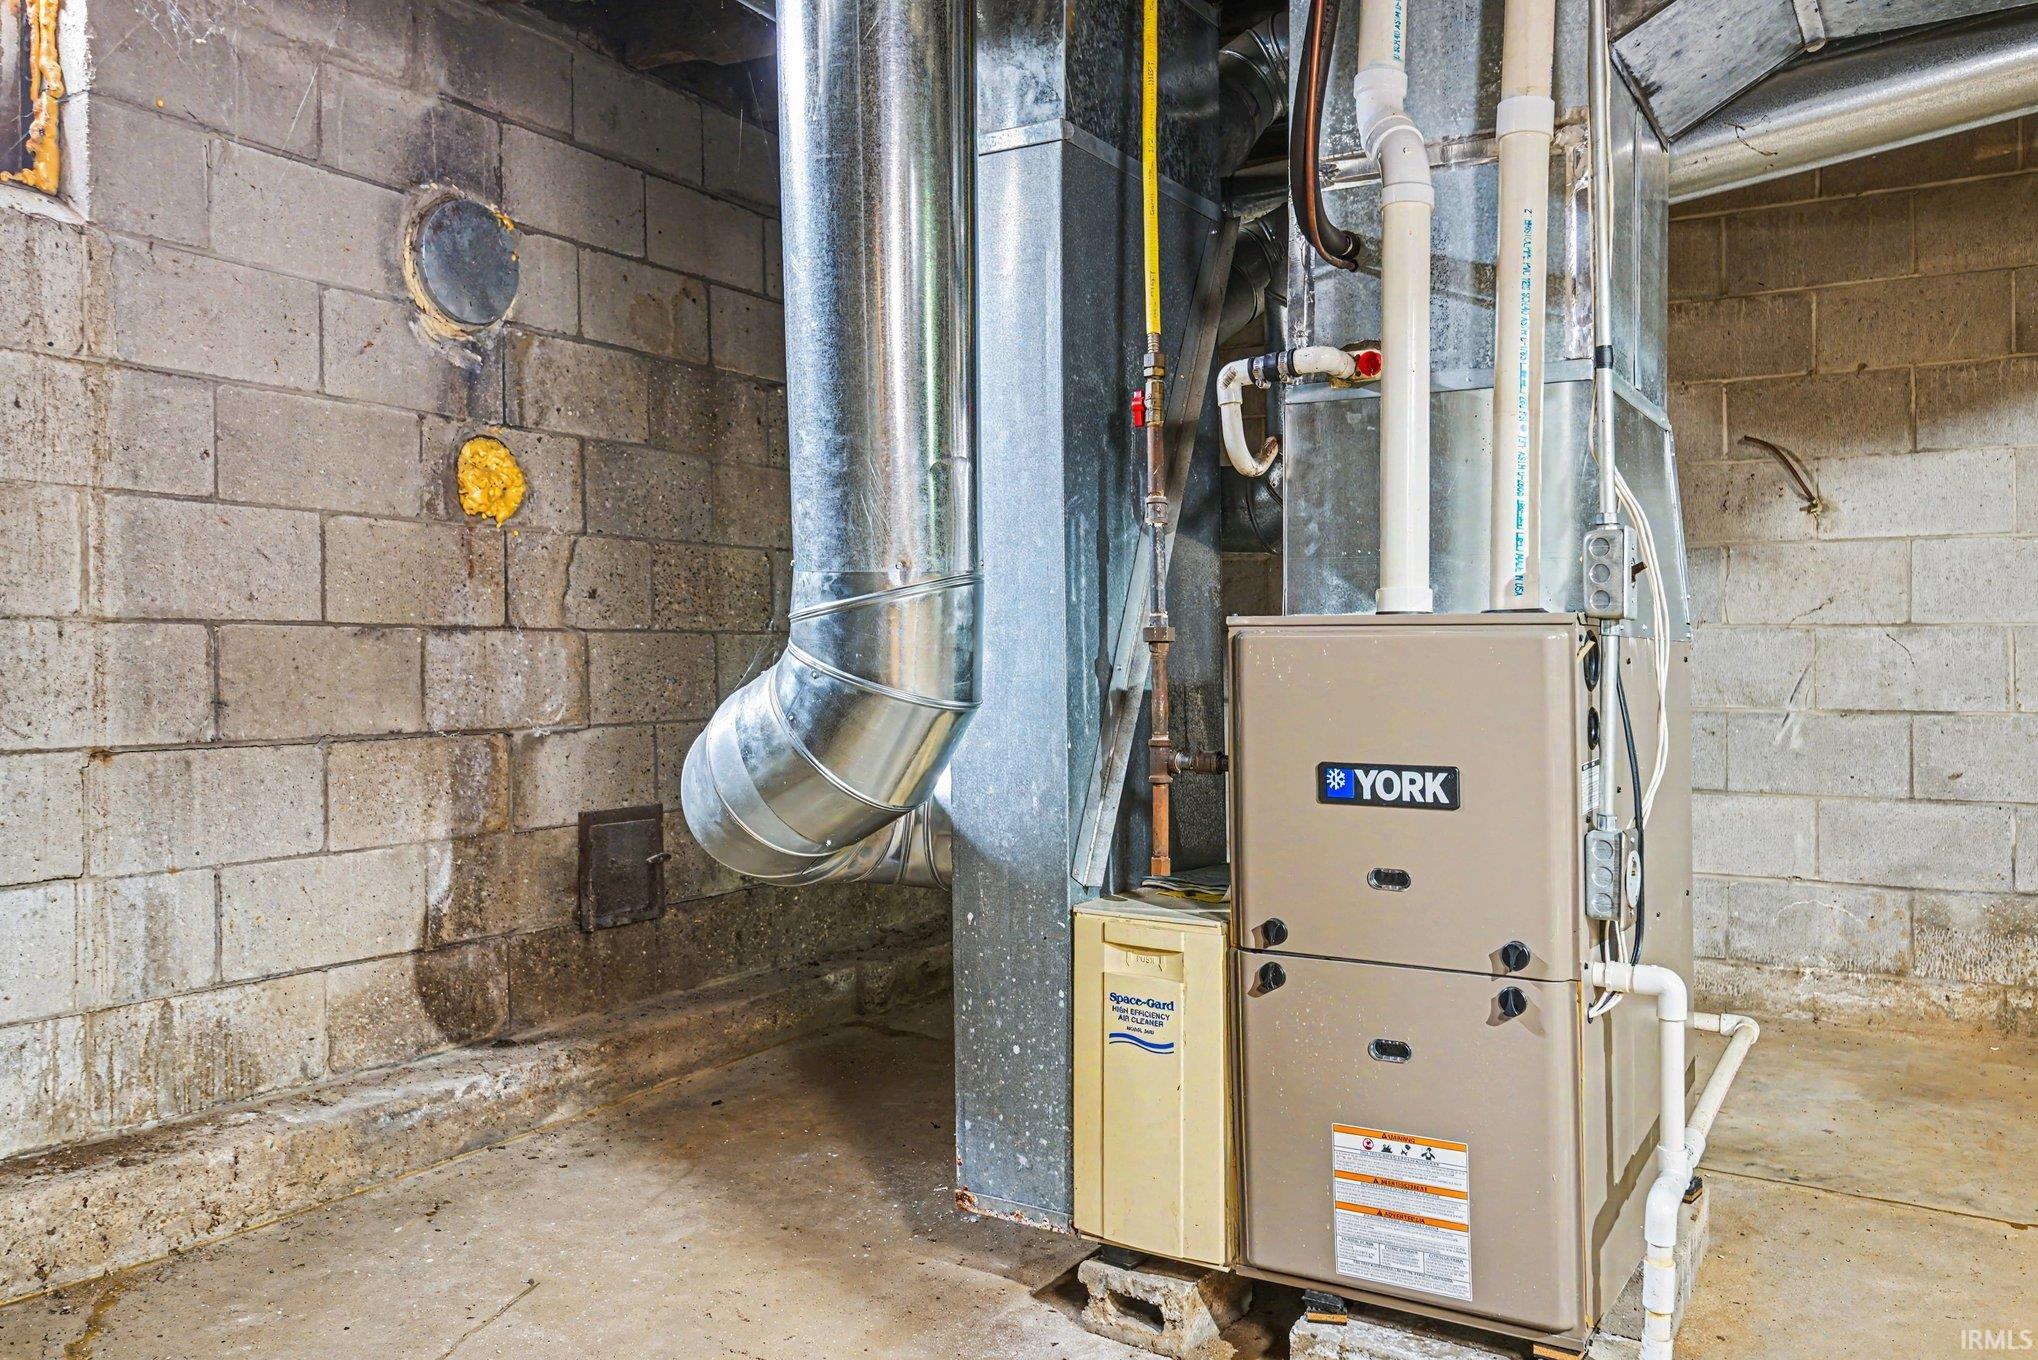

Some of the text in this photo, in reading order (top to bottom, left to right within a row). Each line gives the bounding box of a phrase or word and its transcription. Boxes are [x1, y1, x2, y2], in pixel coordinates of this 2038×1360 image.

[1514, 582, 1524, 597] USA
[1354, 769, 1450, 804] YORK
[1109, 992, 1175, 1011] Space-Gard
[1112, 1005, 1171, 1021] HIGH EFFICIENCY
[1118, 1014, 1164, 1028] AIR CLEANER
